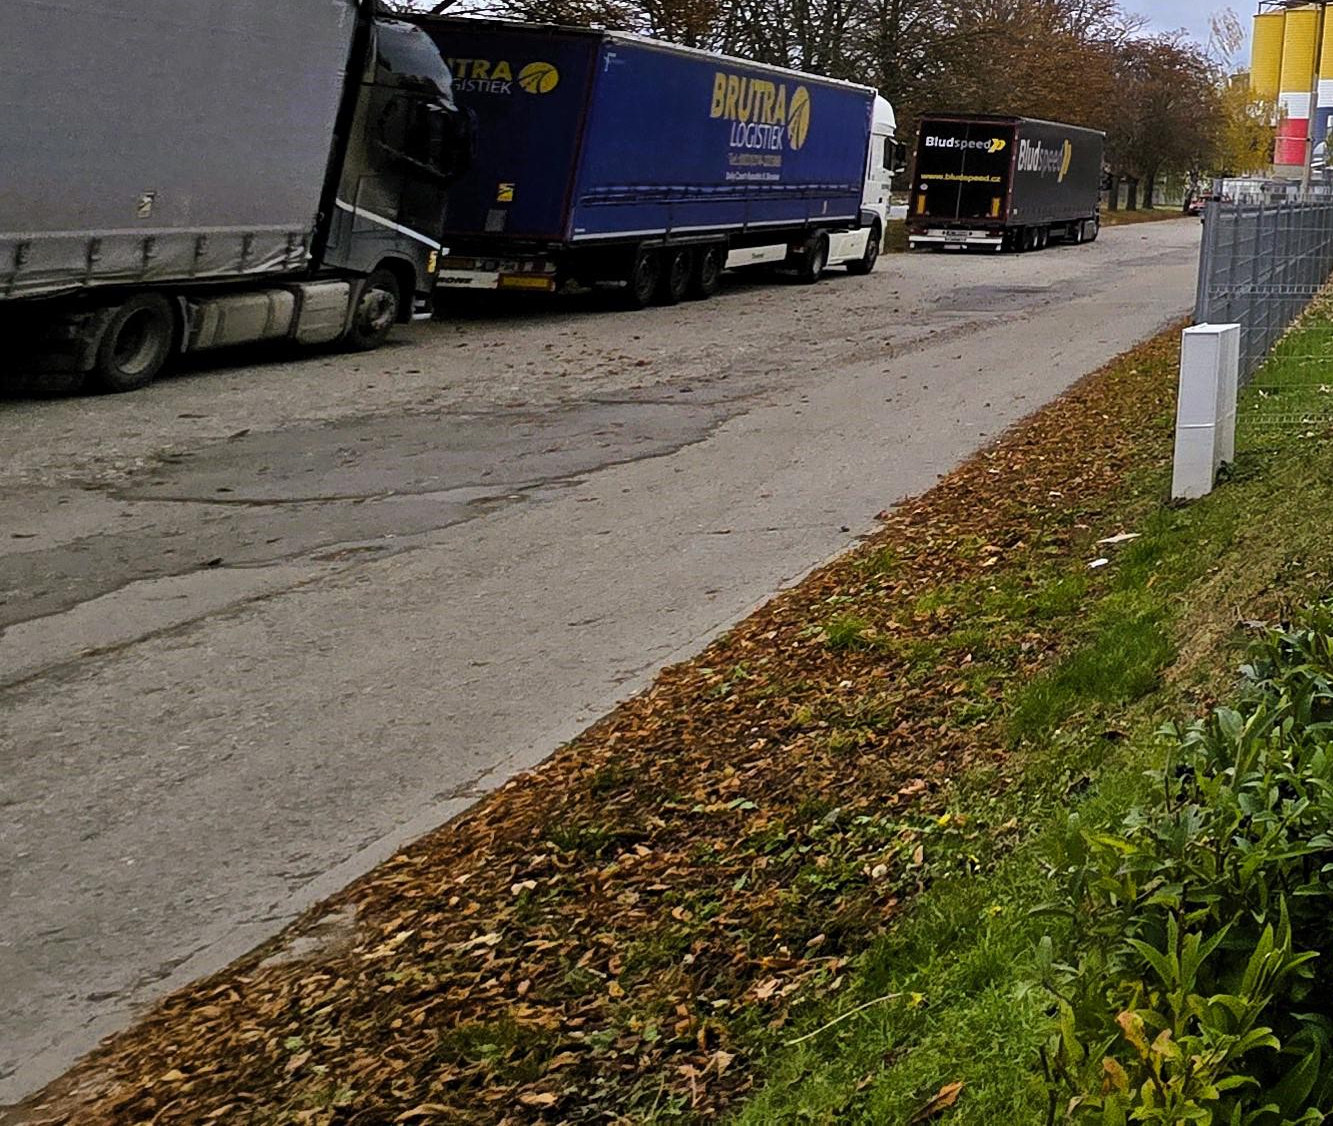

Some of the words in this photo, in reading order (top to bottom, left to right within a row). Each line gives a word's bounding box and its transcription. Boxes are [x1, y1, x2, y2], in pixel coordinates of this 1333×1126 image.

[448, 57, 513, 82] TRA
[453, 77, 513, 95] GISTIEK
[710, 72, 786, 126] BRUTRA
[729, 122, 785, 150] LOGISTIEK
[925, 136, 992, 150] Bludspeed
[1018, 139, 1064, 178] Bludspeed
